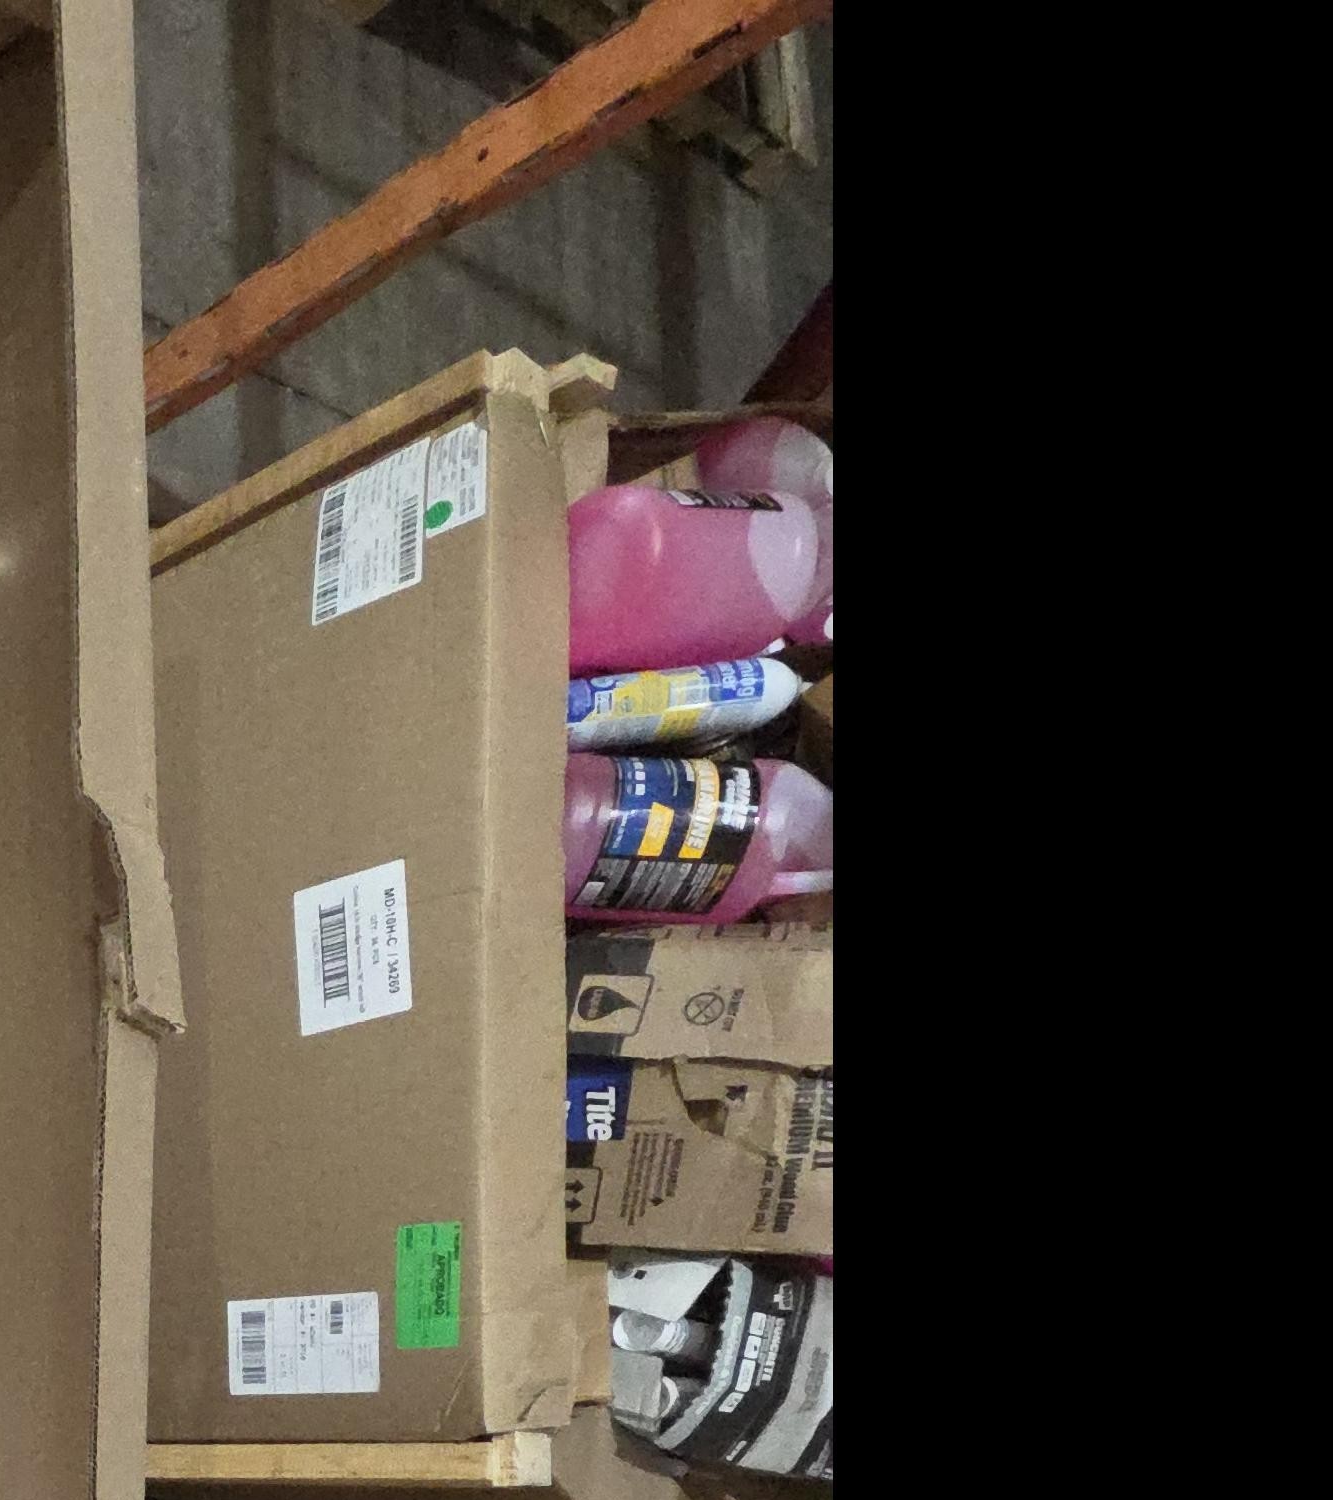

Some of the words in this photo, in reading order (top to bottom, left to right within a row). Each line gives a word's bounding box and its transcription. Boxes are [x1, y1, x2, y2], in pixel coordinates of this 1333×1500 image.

[383, 887, 397, 946] MD-10H-C
[585, 1086, 617, 1141] Tite
[779, 1157, 803, 1199] Wood
[434, 1254, 444, 1315] APROBADO
